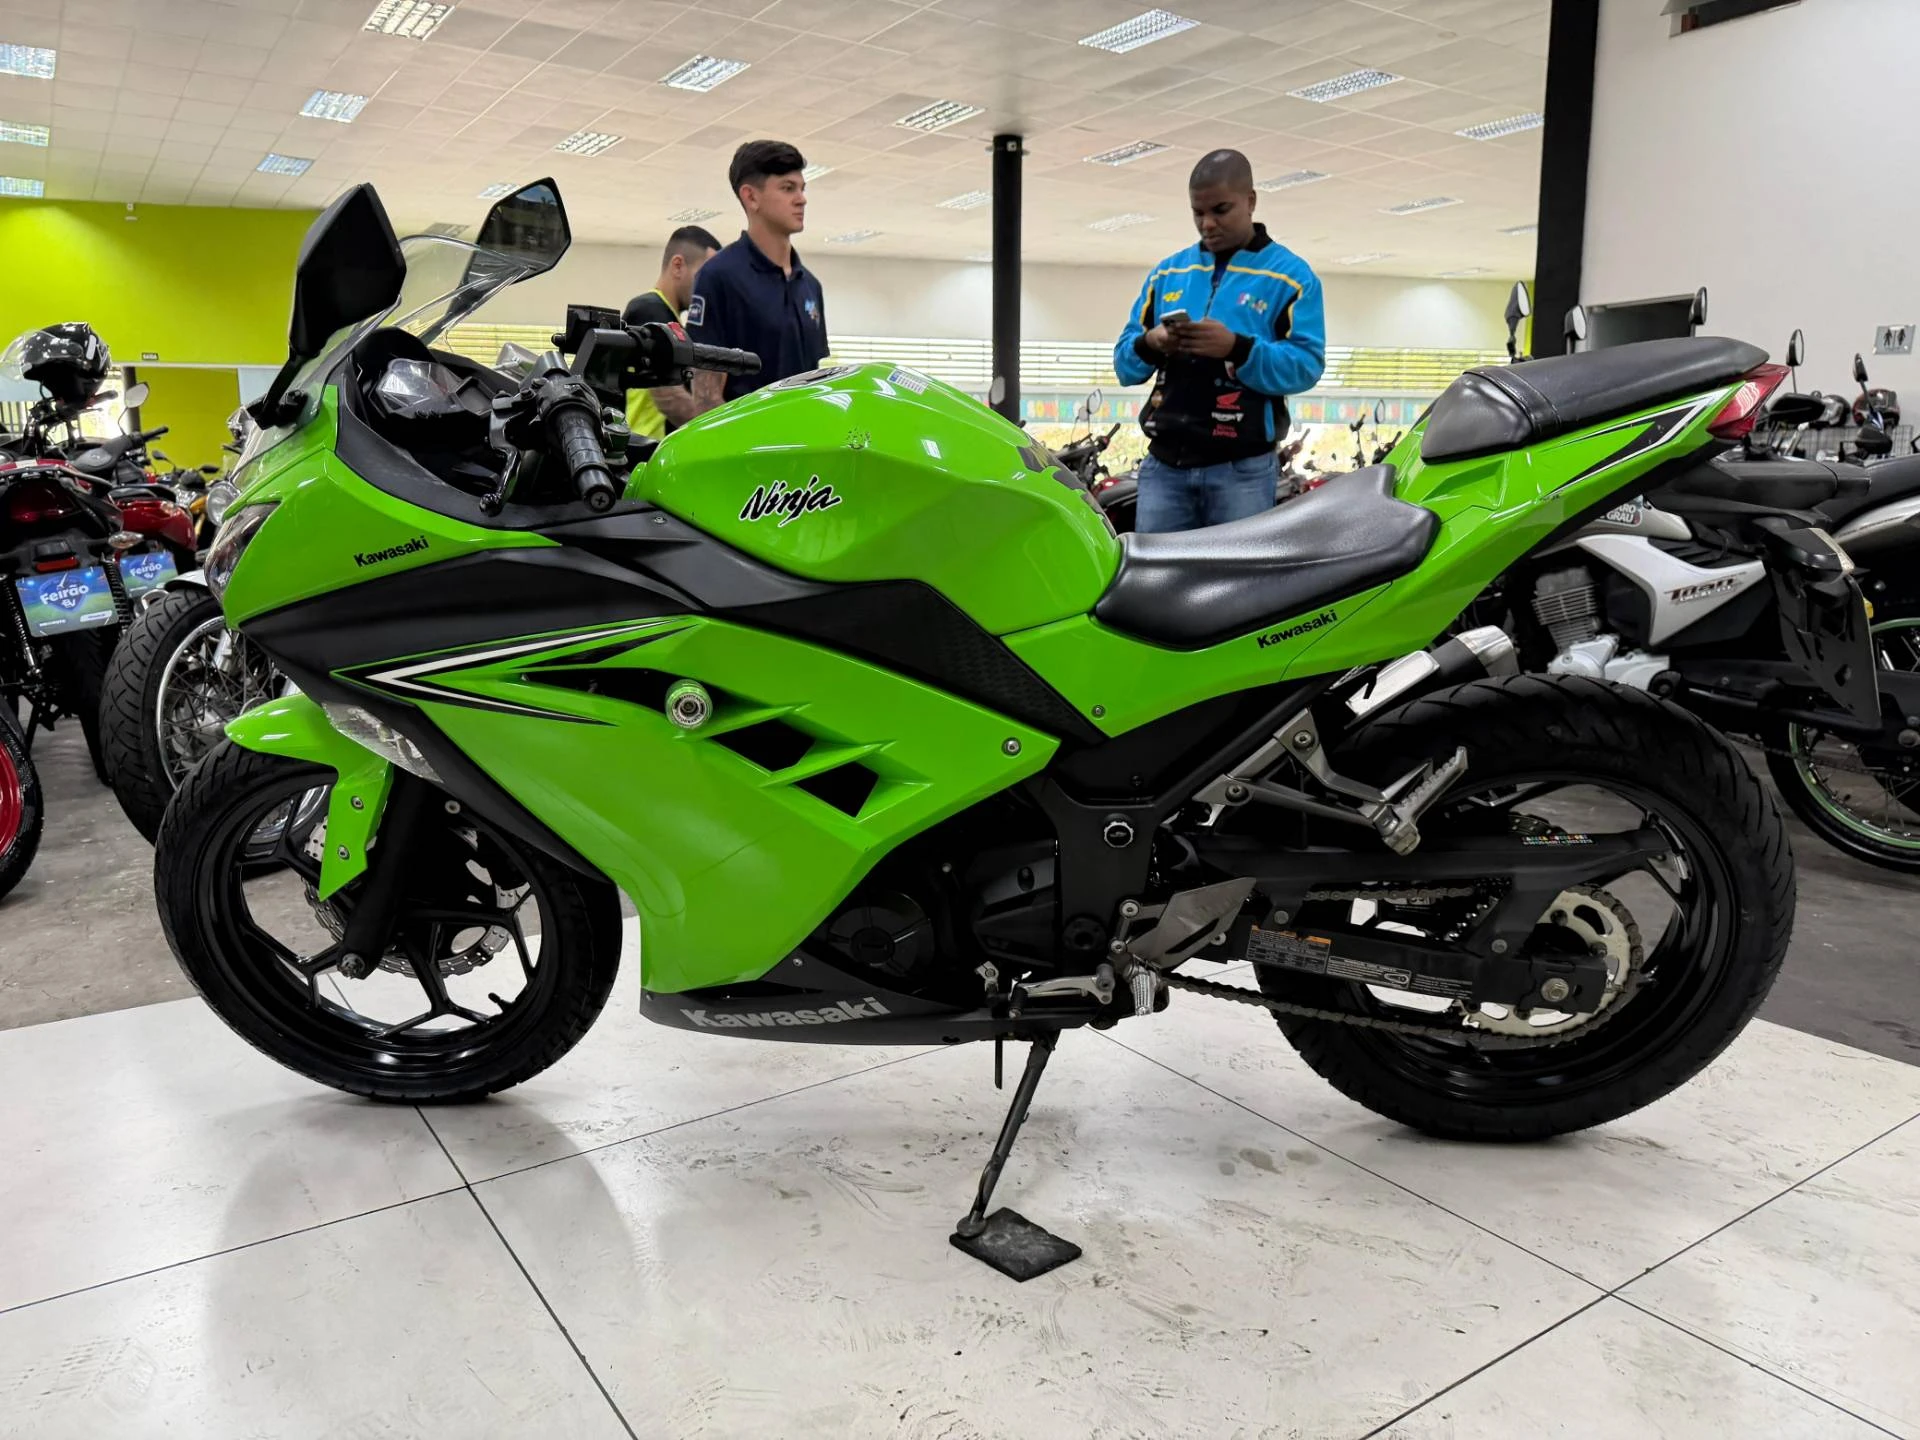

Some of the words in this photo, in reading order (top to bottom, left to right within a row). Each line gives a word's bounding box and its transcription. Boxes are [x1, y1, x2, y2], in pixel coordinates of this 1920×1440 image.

[739, 474, 842, 528] Ninja
[1606, 511, 1634, 523] GRAU
[353, 535, 430, 568] Kawasaki
[39, 584, 89, 605] Feirão
[1256, 609, 1338, 649] Kawasaki
[680, 997, 891, 1028] Kawasaki
